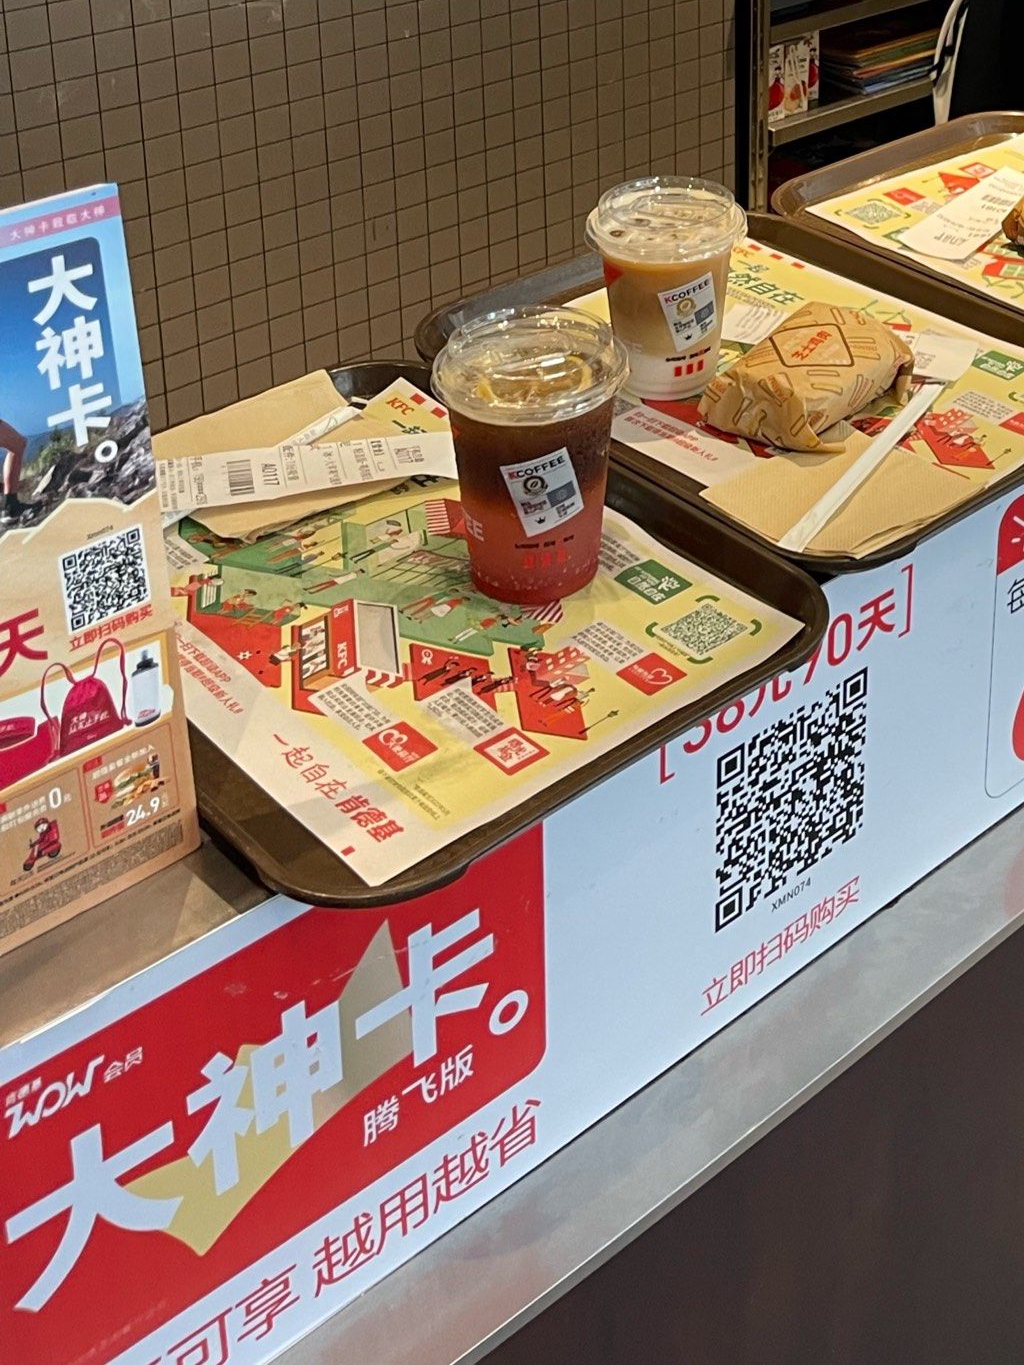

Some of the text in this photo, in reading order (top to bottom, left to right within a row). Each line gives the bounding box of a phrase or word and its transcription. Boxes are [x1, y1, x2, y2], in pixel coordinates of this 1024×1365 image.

[27, 254, 120, 465] 大神卡。
[386, 396, 415, 416] KFC
[260, 462, 281, 486] A0117
[507, 454, 567, 480] KCOFFEE
[335, 641, 350, 670] KFC
[126, 796, 160, 827] 24.9
[770, 877, 813, 913] XMN074
[700, 876, 861, 1016] 立即扫码购买
[103, 1046, 144, 1084] 会员
[363, 1044, 475, 1148] 腾飞版
[149, 1098, 542, 1365] 可享 越用越省
